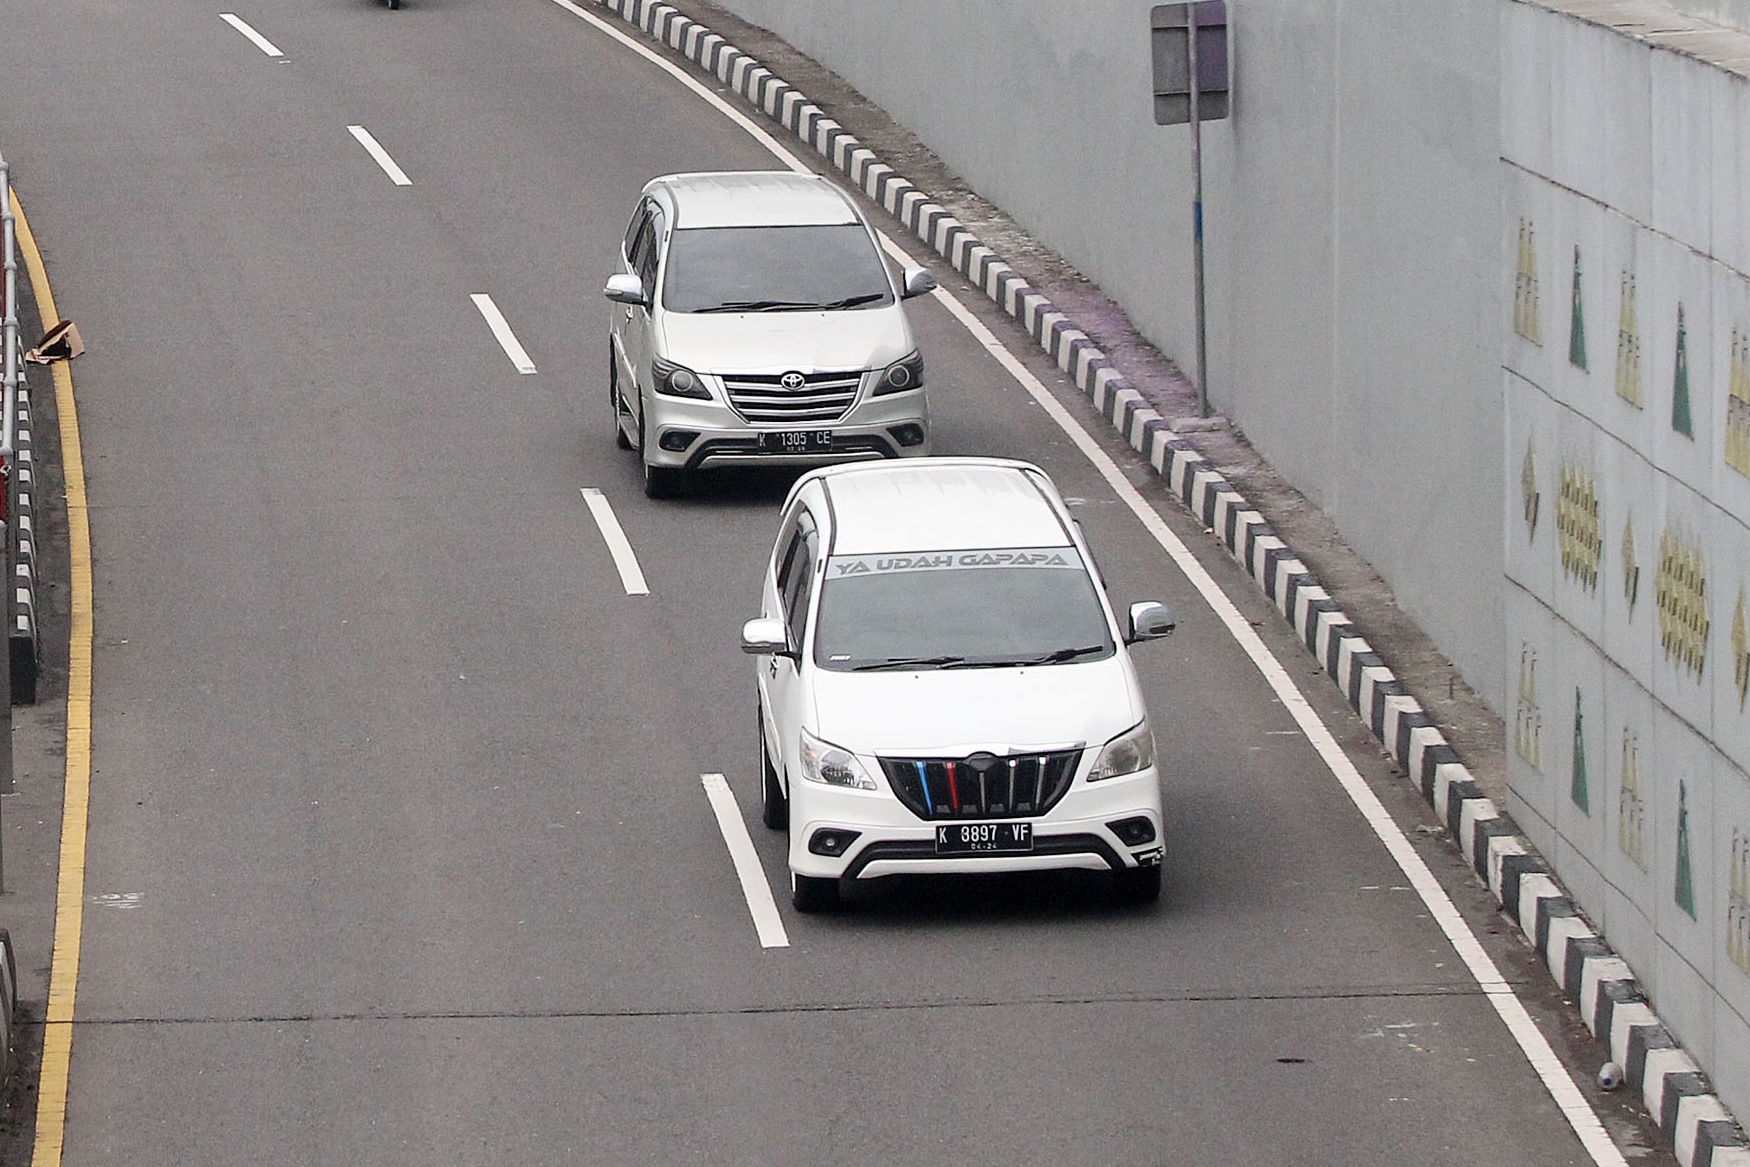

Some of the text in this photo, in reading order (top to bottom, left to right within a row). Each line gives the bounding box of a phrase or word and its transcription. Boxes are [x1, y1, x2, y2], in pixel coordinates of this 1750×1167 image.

[759, 430, 831, 447] K 1305 CE
[836, 552, 1069, 575] YA UDAH GAPAPA
[939, 823, 1029, 844] K 8897 VF
